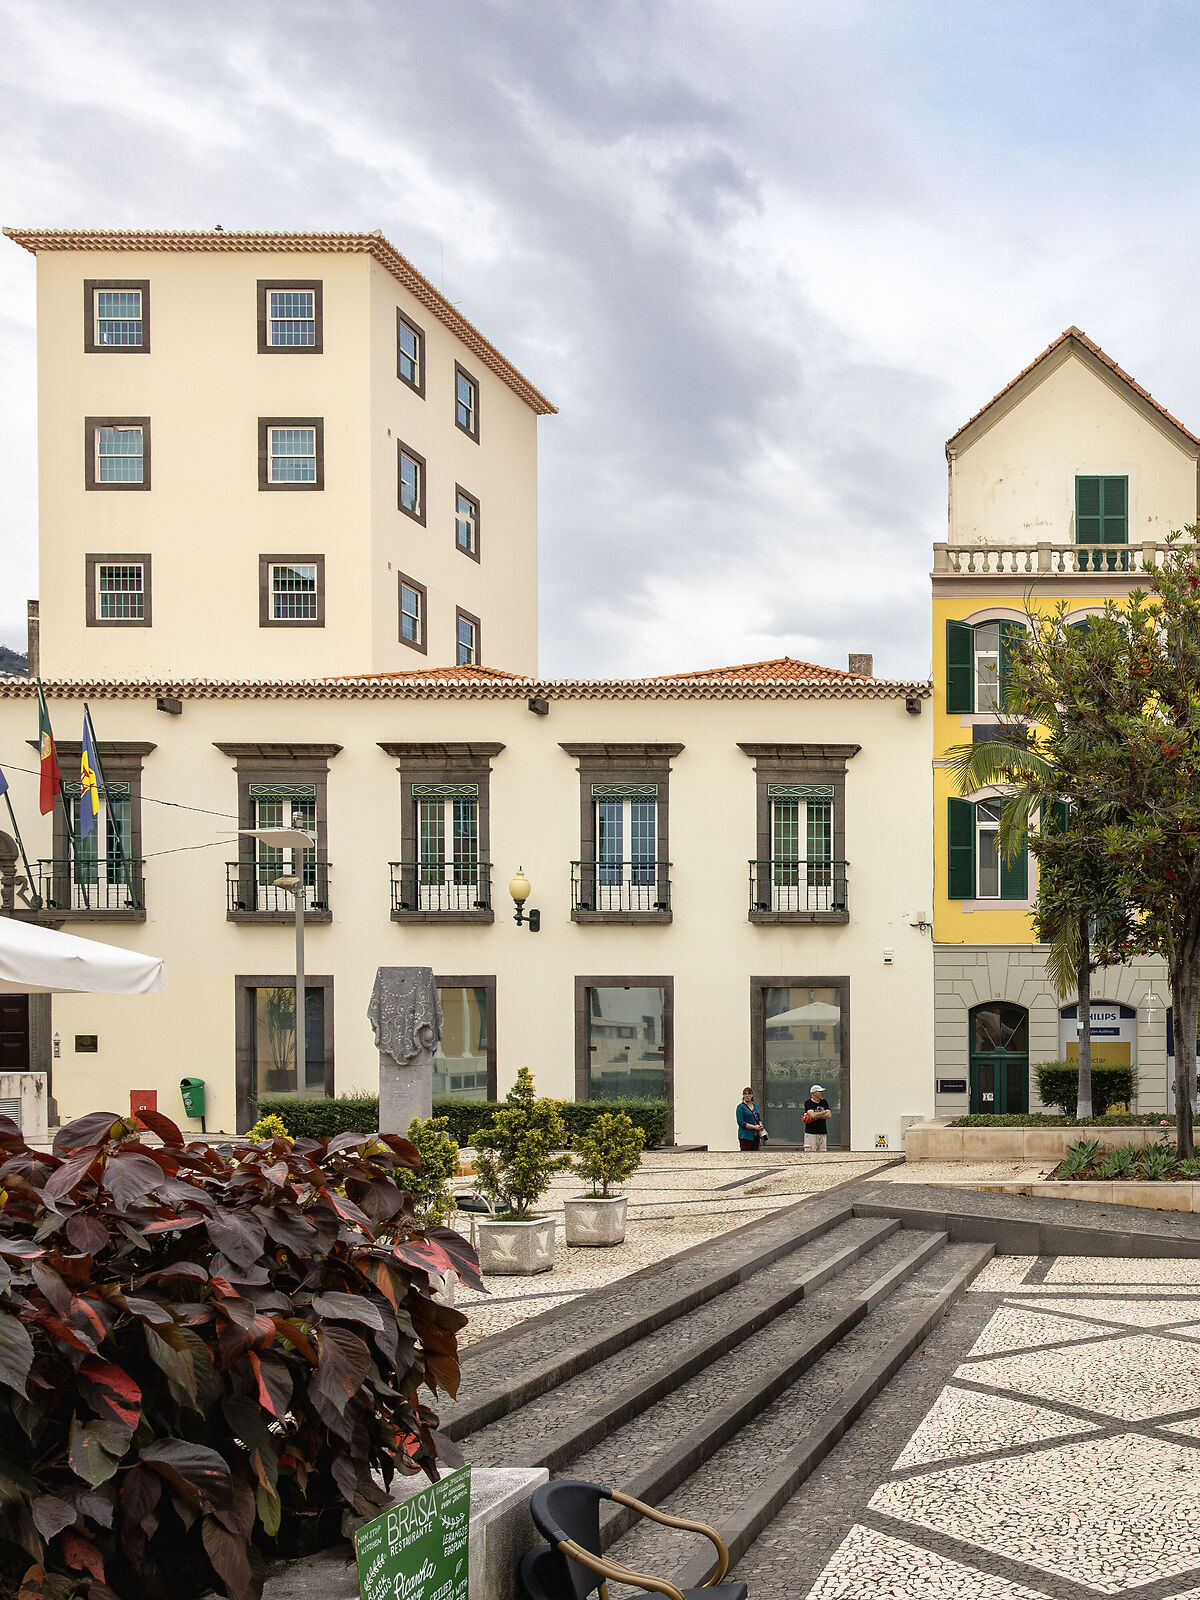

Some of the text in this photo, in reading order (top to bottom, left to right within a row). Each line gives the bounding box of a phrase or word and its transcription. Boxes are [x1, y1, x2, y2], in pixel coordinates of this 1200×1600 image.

[387, 1489, 438, 1546] BRASA
[390, 1521, 433, 1557] RESTAURANTE
[367, 1574, 387, 1600] BLACK
